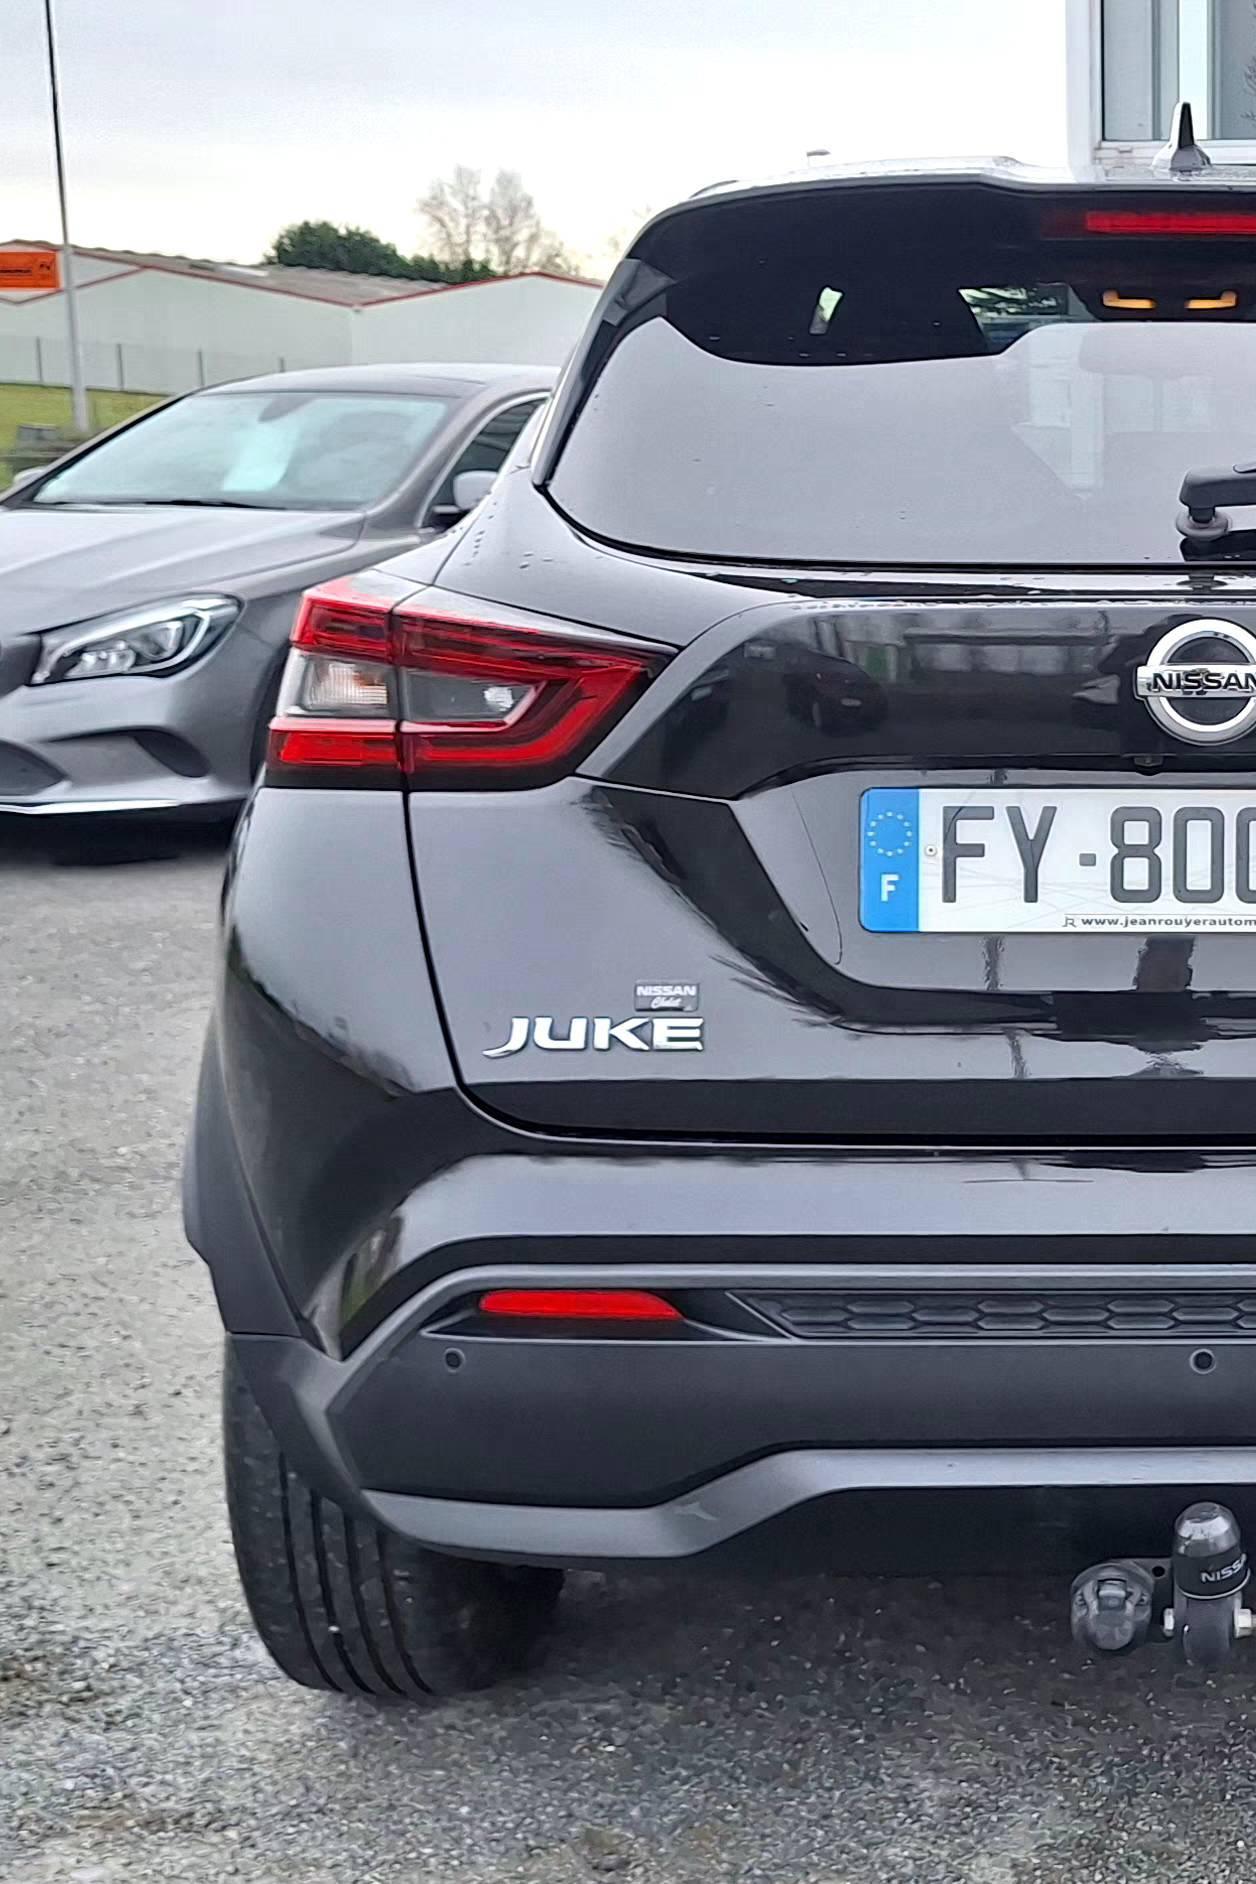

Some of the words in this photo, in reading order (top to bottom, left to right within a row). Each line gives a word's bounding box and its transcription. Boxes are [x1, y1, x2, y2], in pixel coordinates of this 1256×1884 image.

[881, 875, 898, 901] F
[636, 985, 696, 996] NISSAN
[483, 1016, 703, 1057] JUKE
